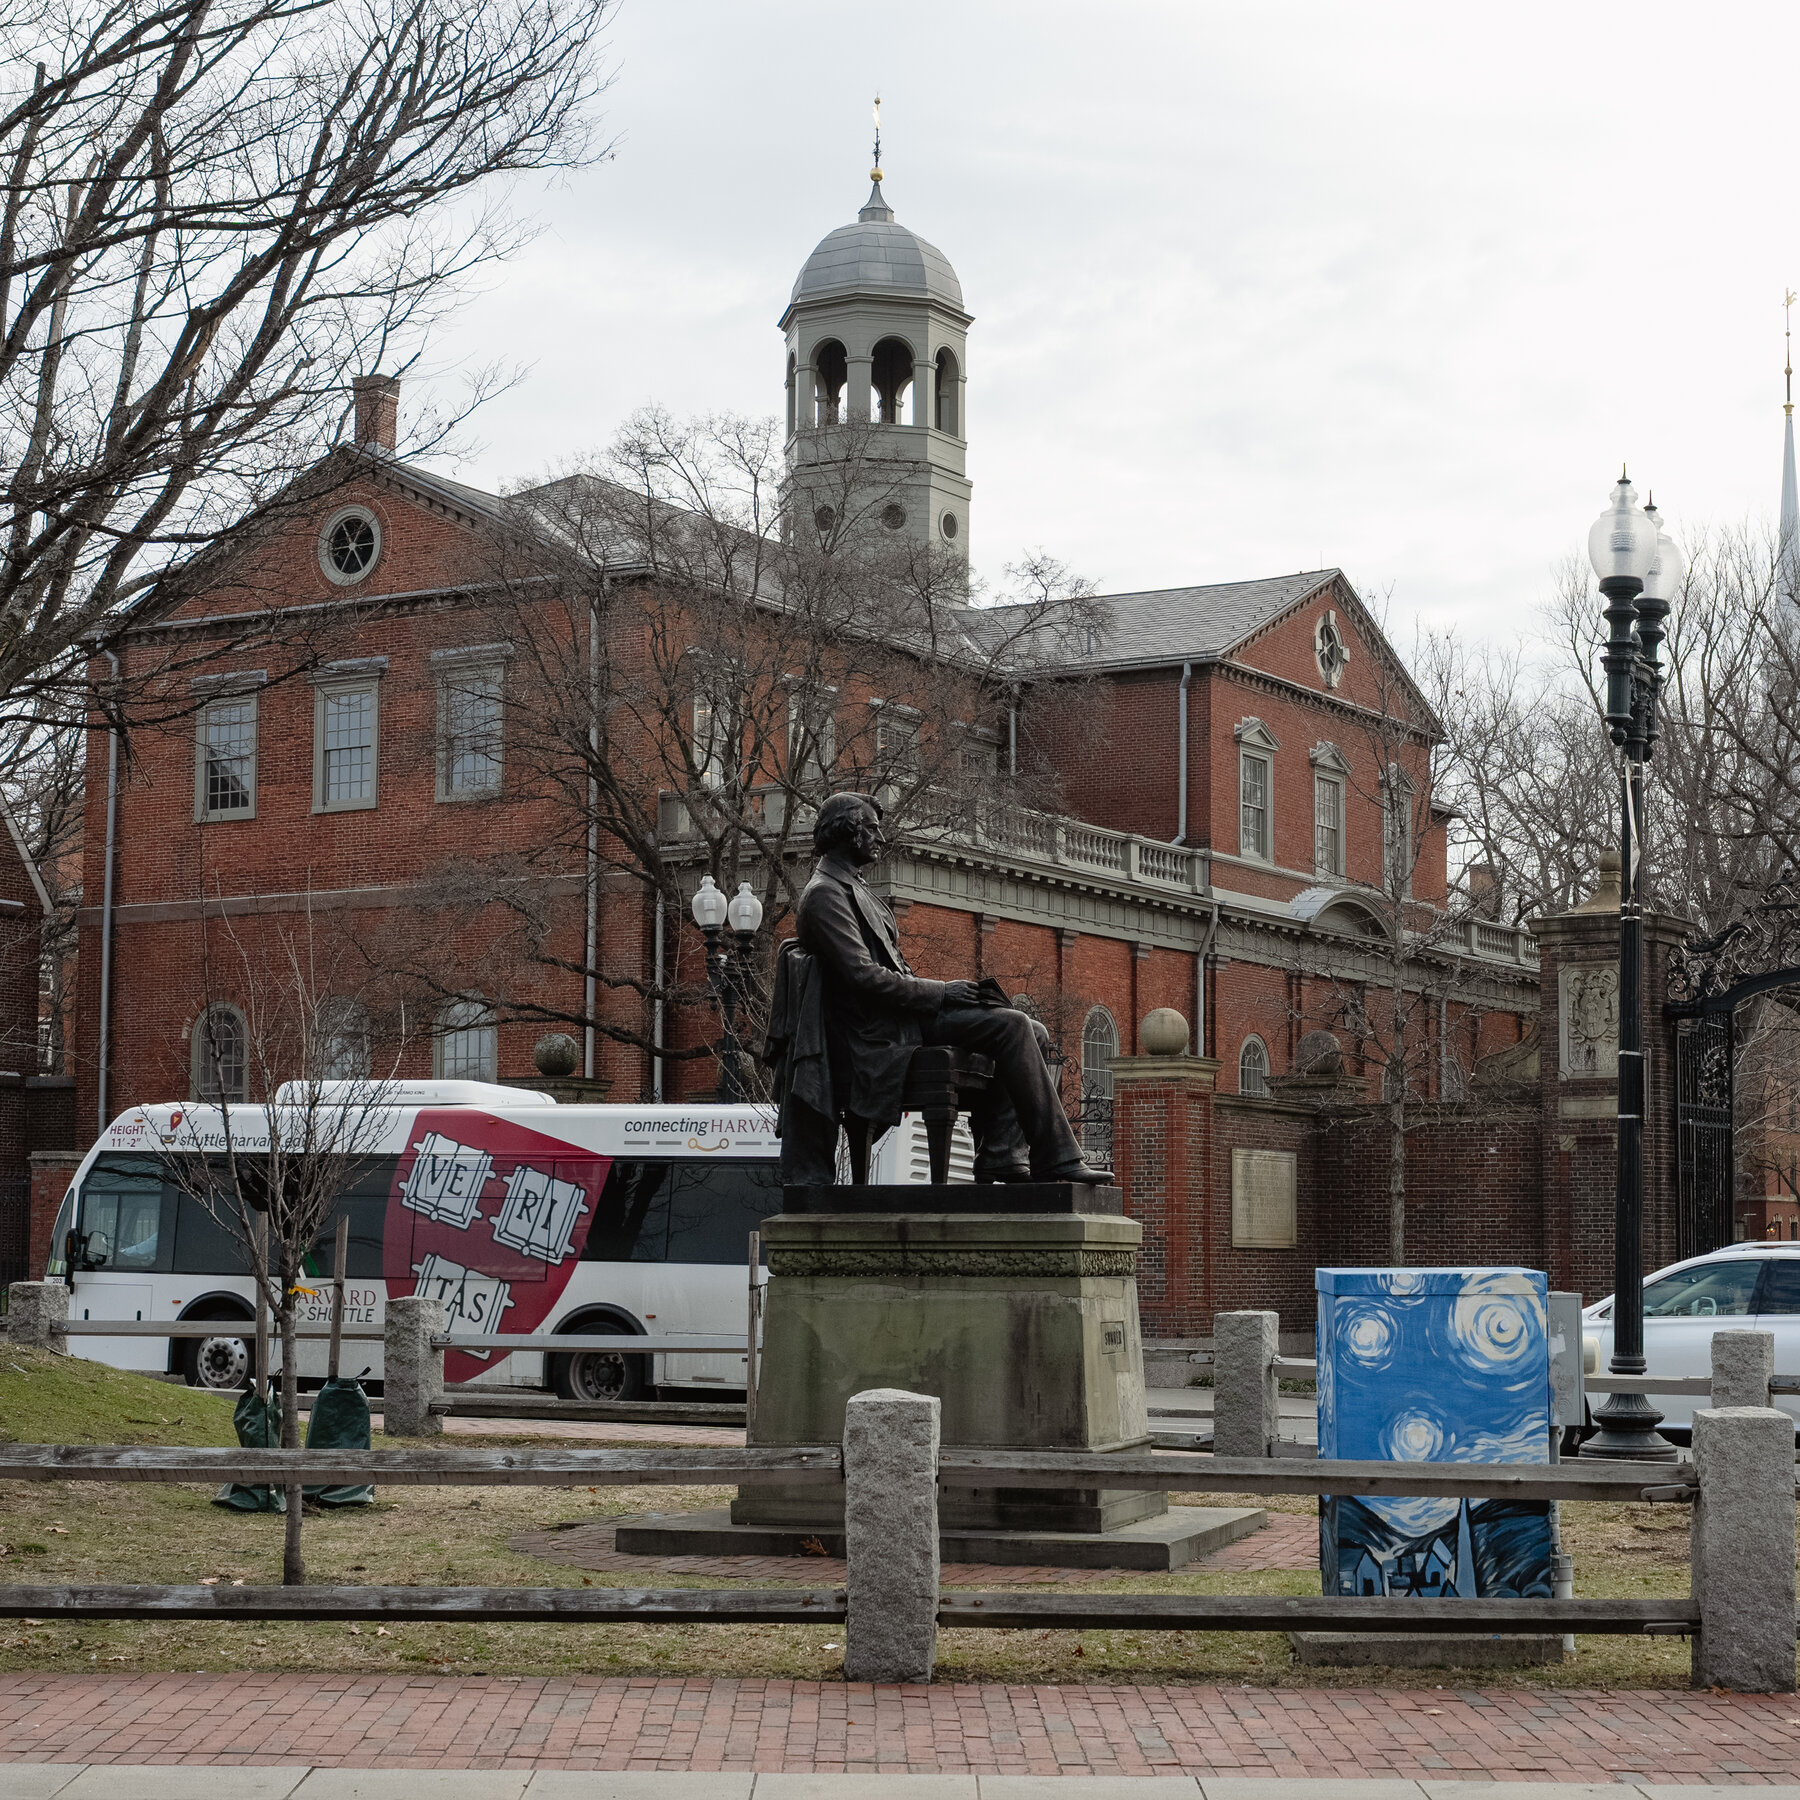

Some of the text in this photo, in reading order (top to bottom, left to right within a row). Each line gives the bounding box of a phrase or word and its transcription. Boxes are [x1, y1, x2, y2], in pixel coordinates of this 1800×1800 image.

[109, 1125, 145, 1135] HEIGHT
[624, 1117, 709, 1137] connecting
[430, 1153, 468, 1196] VE
[516, 1188, 558, 1230] RI
[52, 1277, 63, 1285] 203
[297, 1289, 377, 1306] ARVRD
[436, 1274, 488, 1323] TAS
